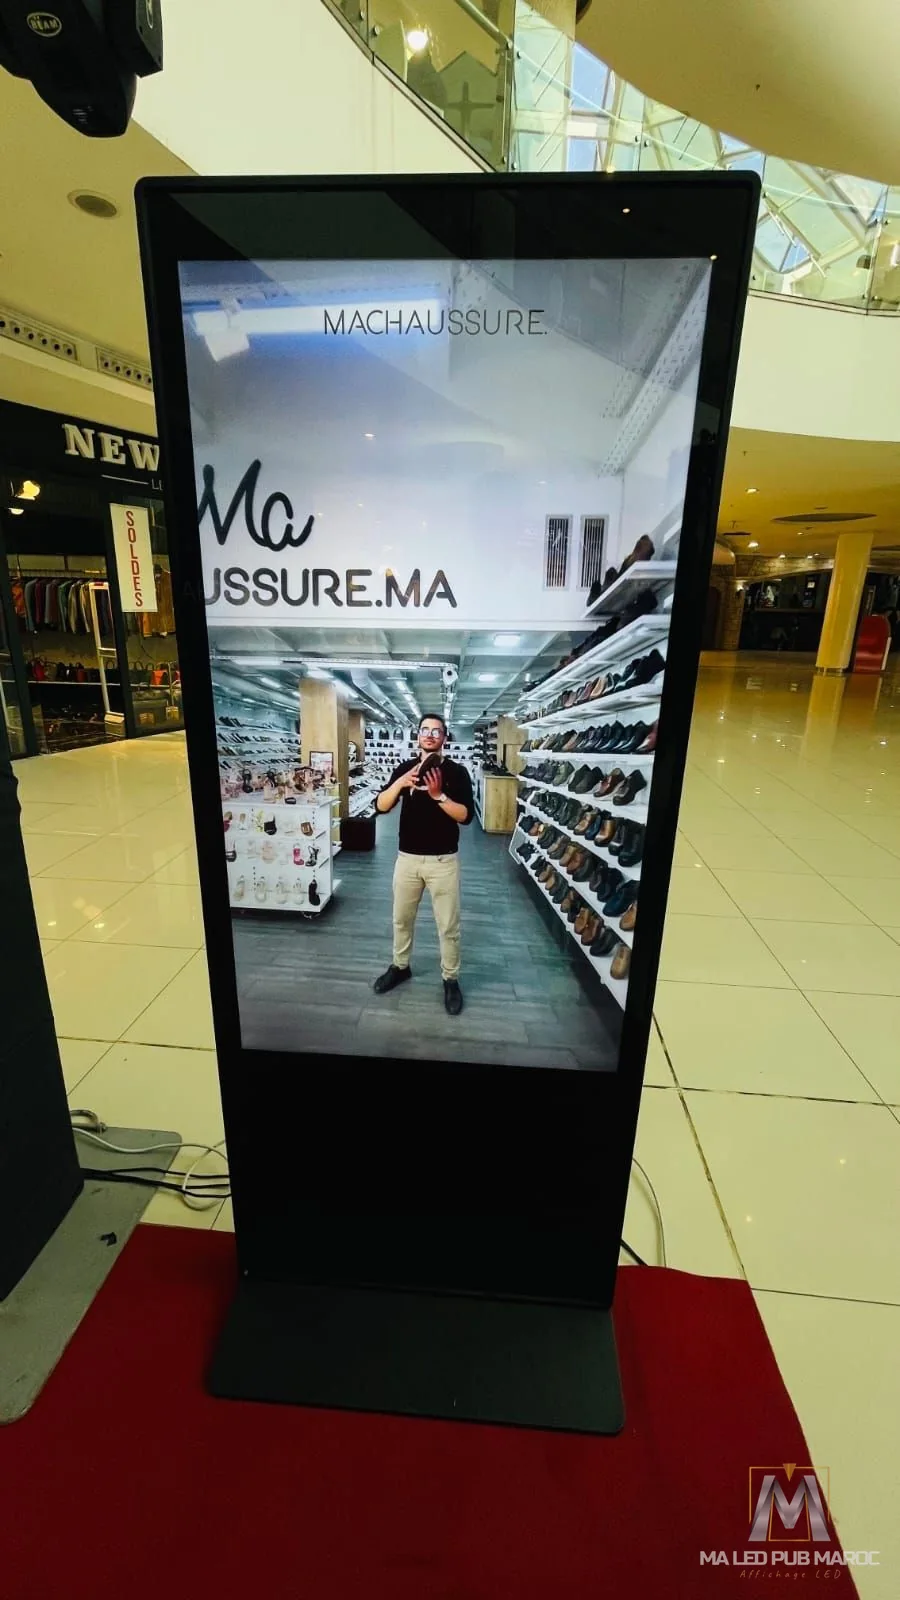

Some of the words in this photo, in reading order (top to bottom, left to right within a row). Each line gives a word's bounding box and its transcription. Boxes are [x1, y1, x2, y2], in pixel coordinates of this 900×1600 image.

[324, 309, 548, 335] MACHAUSSURE.
[62, 423, 160, 472] NEW
[198, 458, 315, 552] Ma
[126, 510, 144, 608] SOLDES
